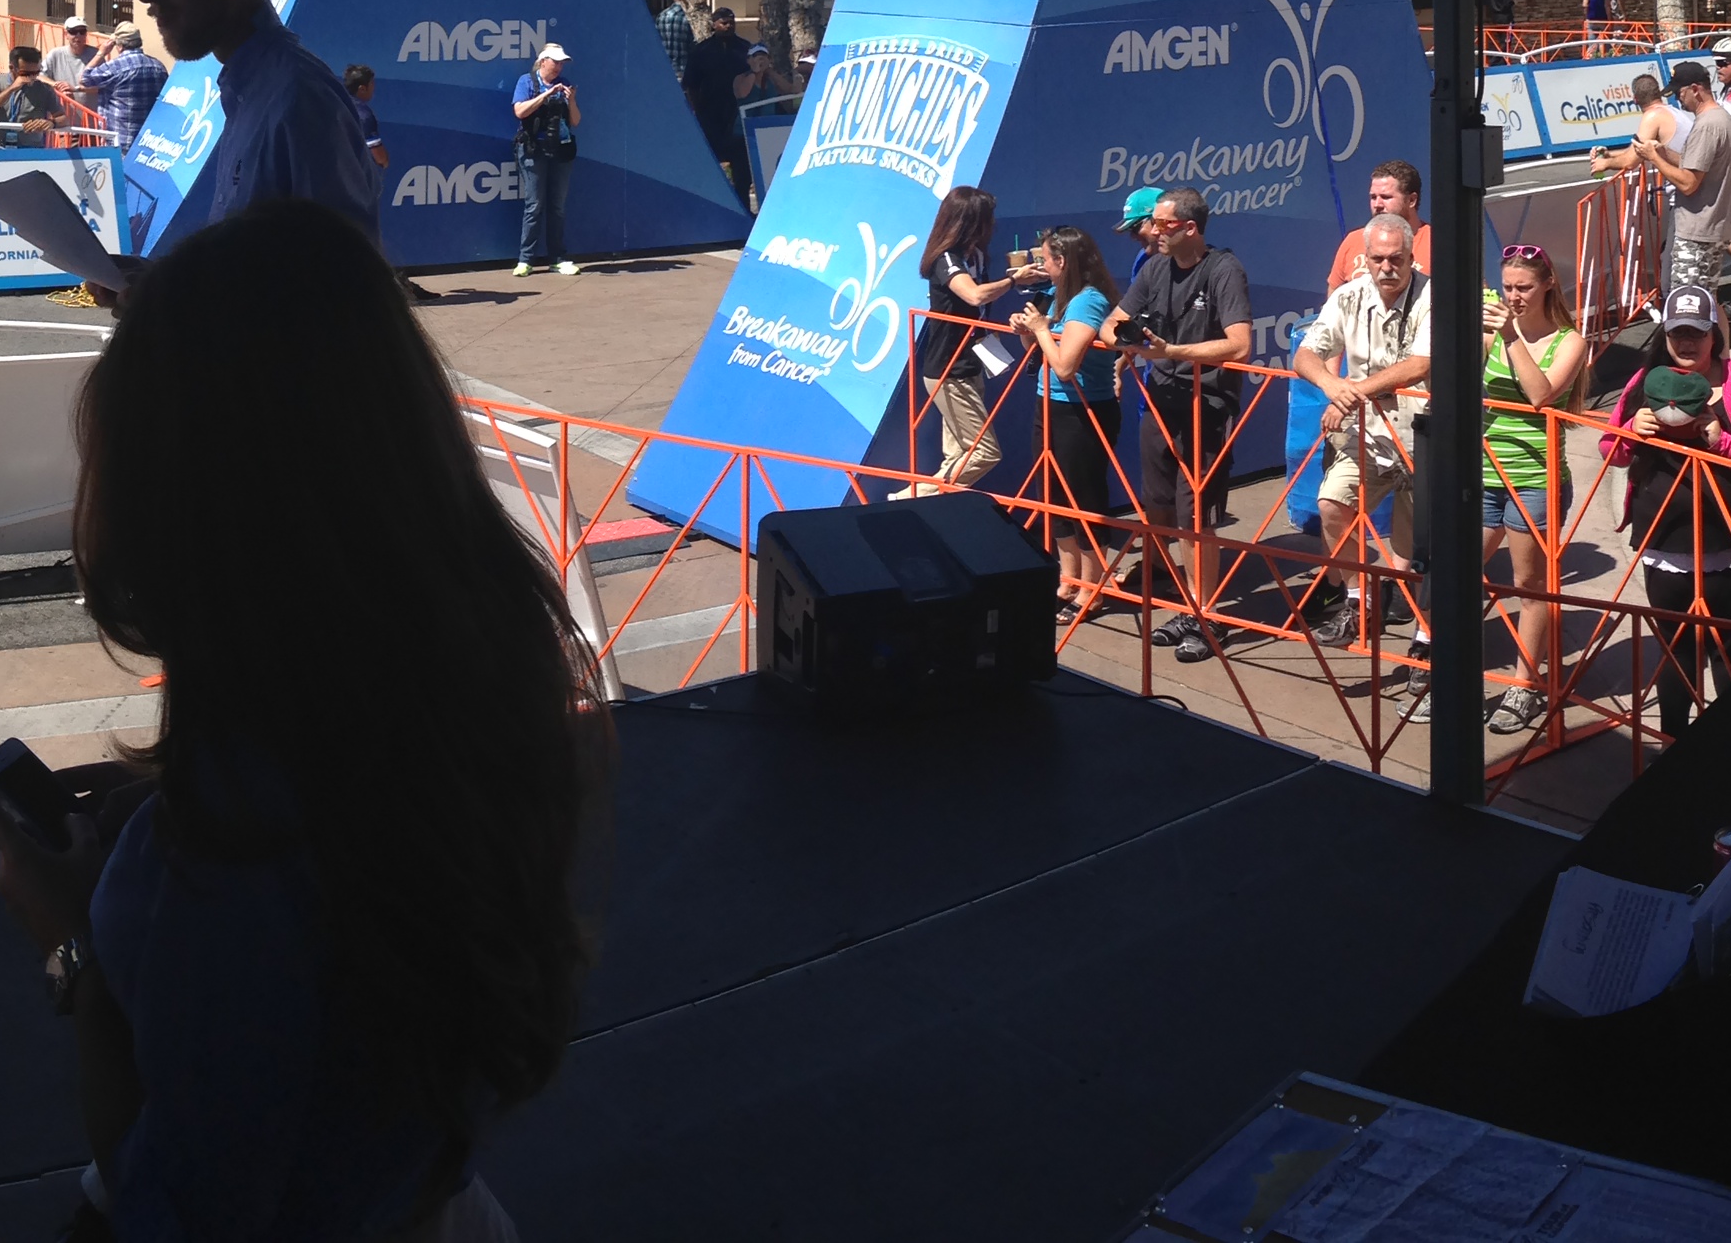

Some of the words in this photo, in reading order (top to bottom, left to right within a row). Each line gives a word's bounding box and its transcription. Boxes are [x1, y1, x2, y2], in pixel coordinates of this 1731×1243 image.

[397, 19, 546, 63] AMGEN
[858, 40, 919, 56] FREEZE
[925, 40, 975, 67] DRIED
[1103, 25, 1230, 74] AMGEN
[814, 58, 988, 167] CRUNCHIES
[1602, 85, 1632, 99] visit
[1560, 93, 1643, 136] Californ
[810, 144, 877, 168] NATURAL
[879, 148, 936, 190] SNACKS
[1096, 136, 1309, 193] Breakaway
[1202, 180, 1294, 217] Cancer
[759, 236, 834, 273] AMGEN
[723, 306, 849, 368] Breakaway
[727, 343, 761, 365] from
[761, 350, 825, 385] Cancer
